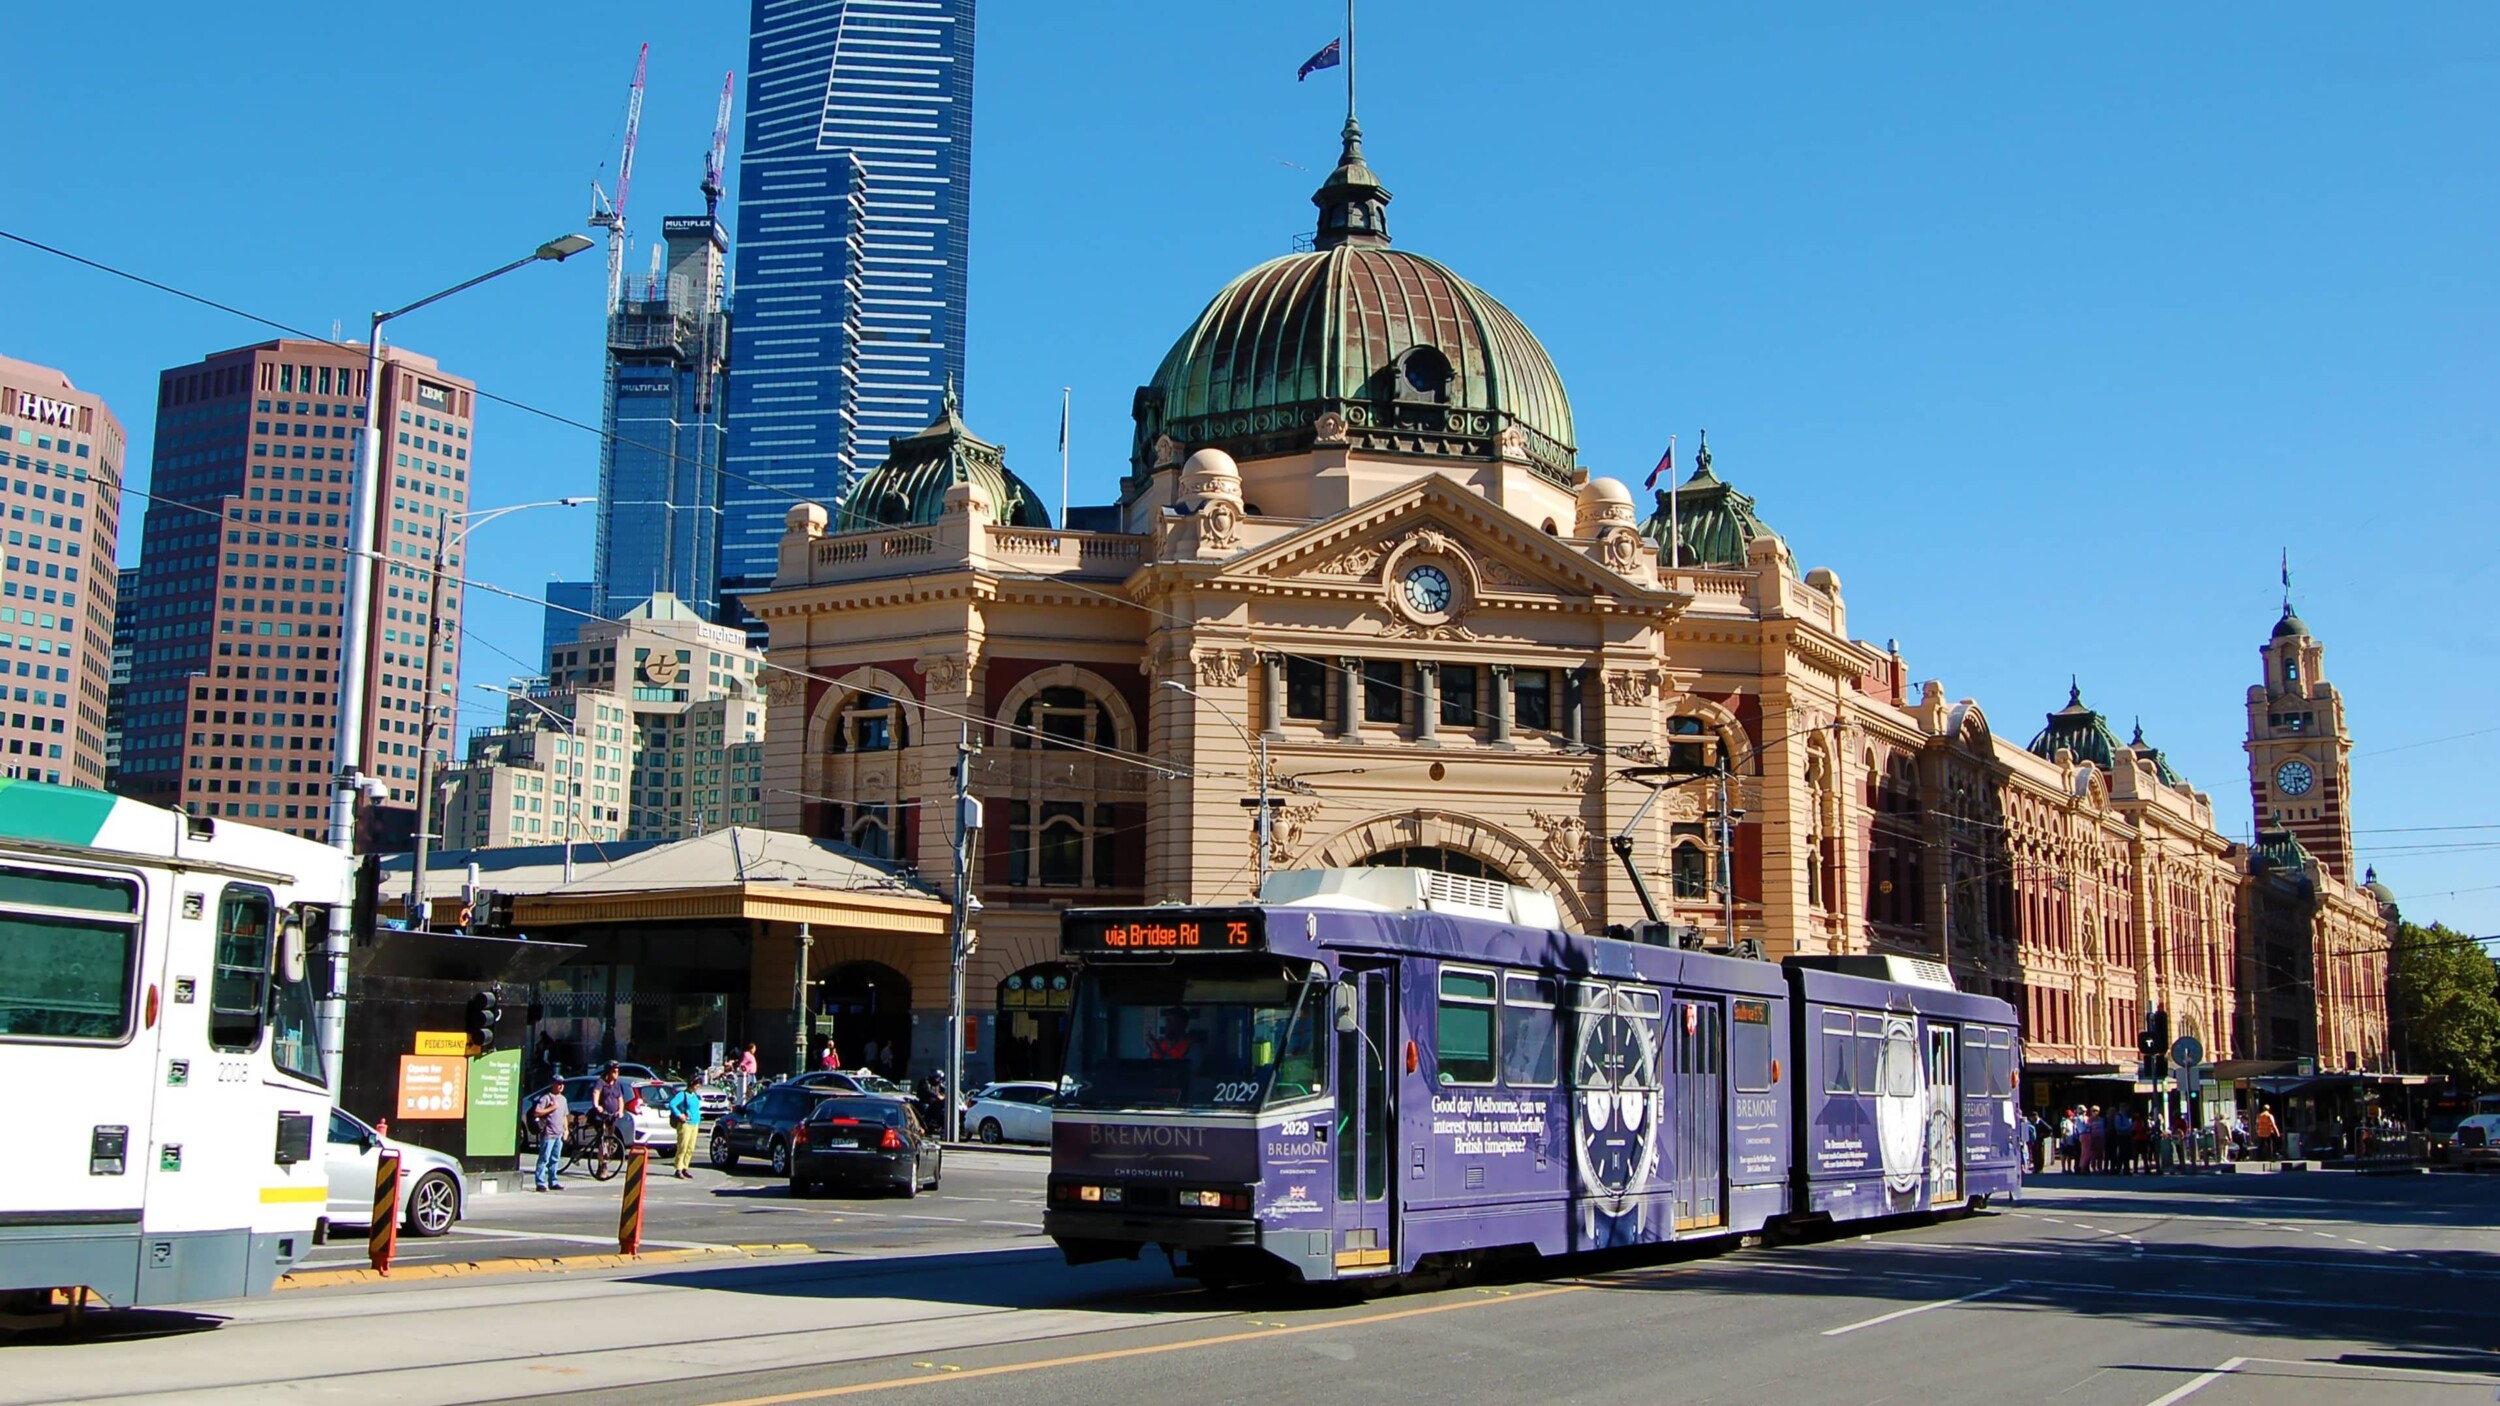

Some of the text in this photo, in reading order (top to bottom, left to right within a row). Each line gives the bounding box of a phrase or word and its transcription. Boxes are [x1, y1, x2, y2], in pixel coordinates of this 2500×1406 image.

[421, 385, 444, 402] IBM
[20, 393, 77, 425] HWT
[696, 621, 746, 646] Langham
[1105, 922, 1248, 946] via Bridge Rd 75
[218, 1061, 249, 1083] 2008
[1213, 1081, 1260, 1102] 2029
[1432, 1096, 1547, 1117] Good day Melbourne, can we
[1736, 1100, 1778, 1117] BREMONT
[1090, 1125, 1208, 1147] BREMONT
[1281, 1121, 1309, 1136] 2029
[1433, 1116, 1545, 1137] interest you in a wonderfully
[1267, 1143, 1328, 1156] BREMONT
[1454, 1136, 1527, 1157] British timepiece?
[1114, 1168, 1184, 1178] CHRONOMETERS
